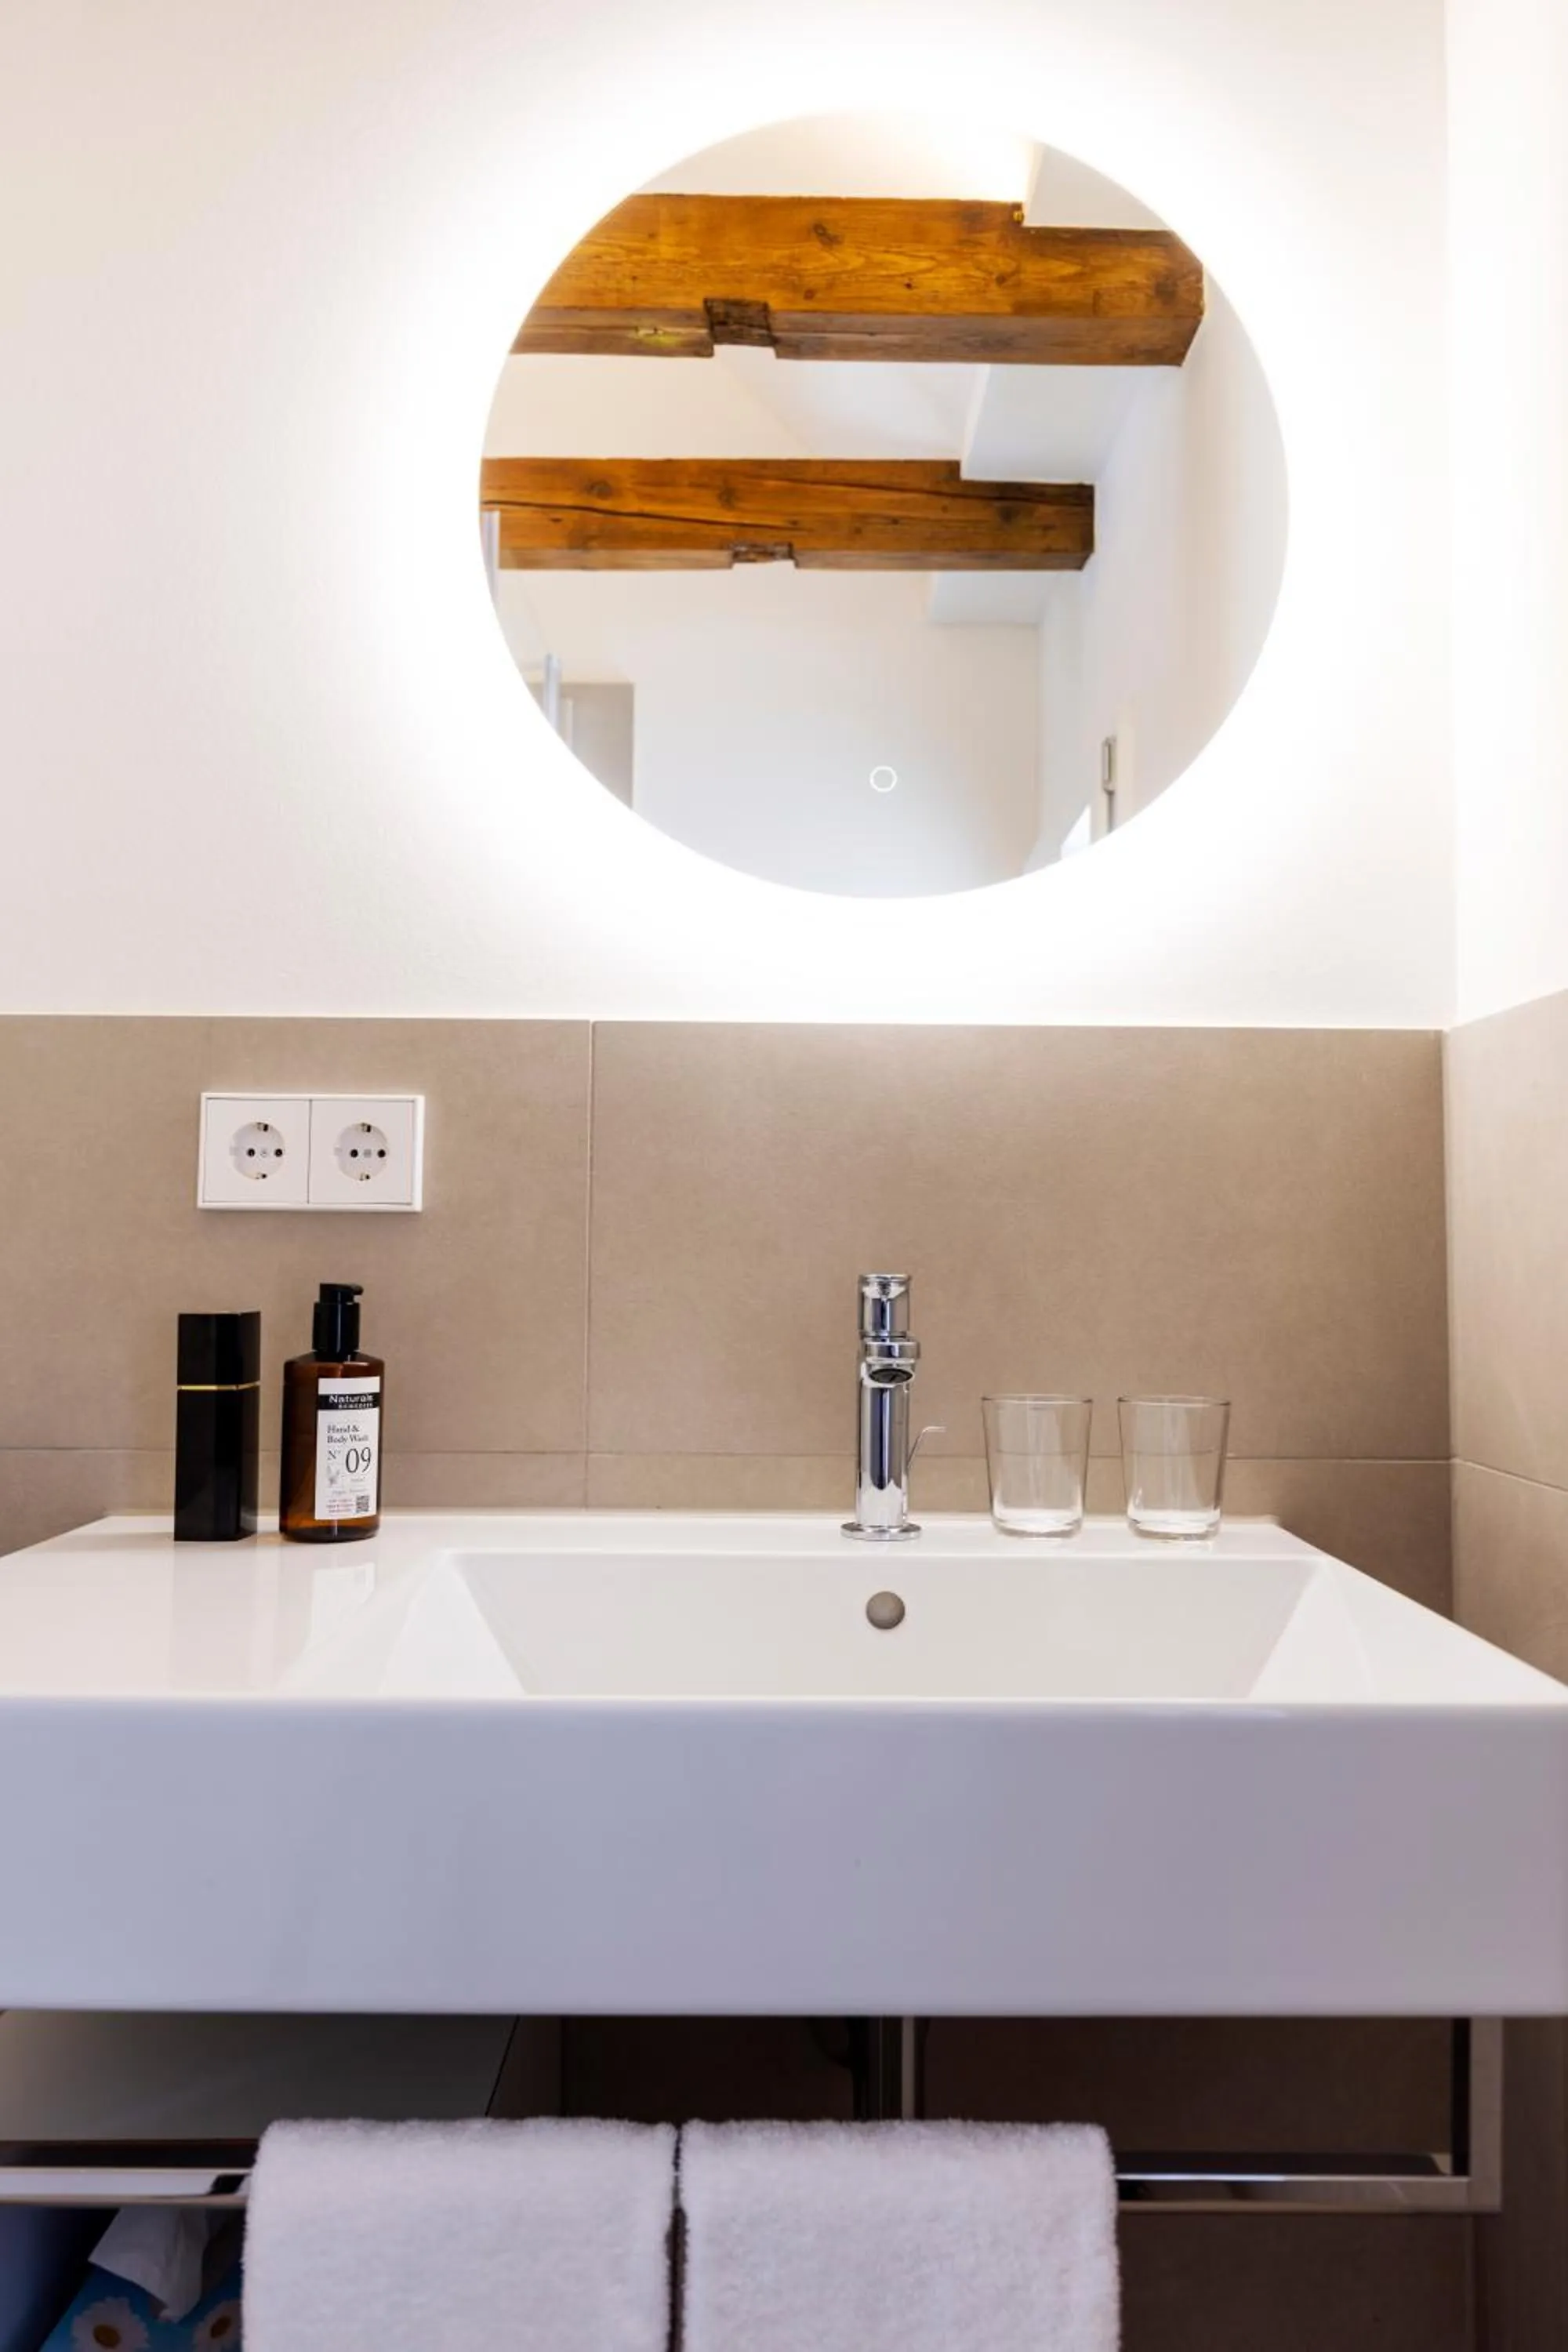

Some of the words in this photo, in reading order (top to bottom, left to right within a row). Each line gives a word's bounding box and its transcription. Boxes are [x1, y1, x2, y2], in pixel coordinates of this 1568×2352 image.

[327, 1425, 350, 1434] Hand
[327, 1435, 348, 1444] Body
[346, 1447, 371, 1473] 09
